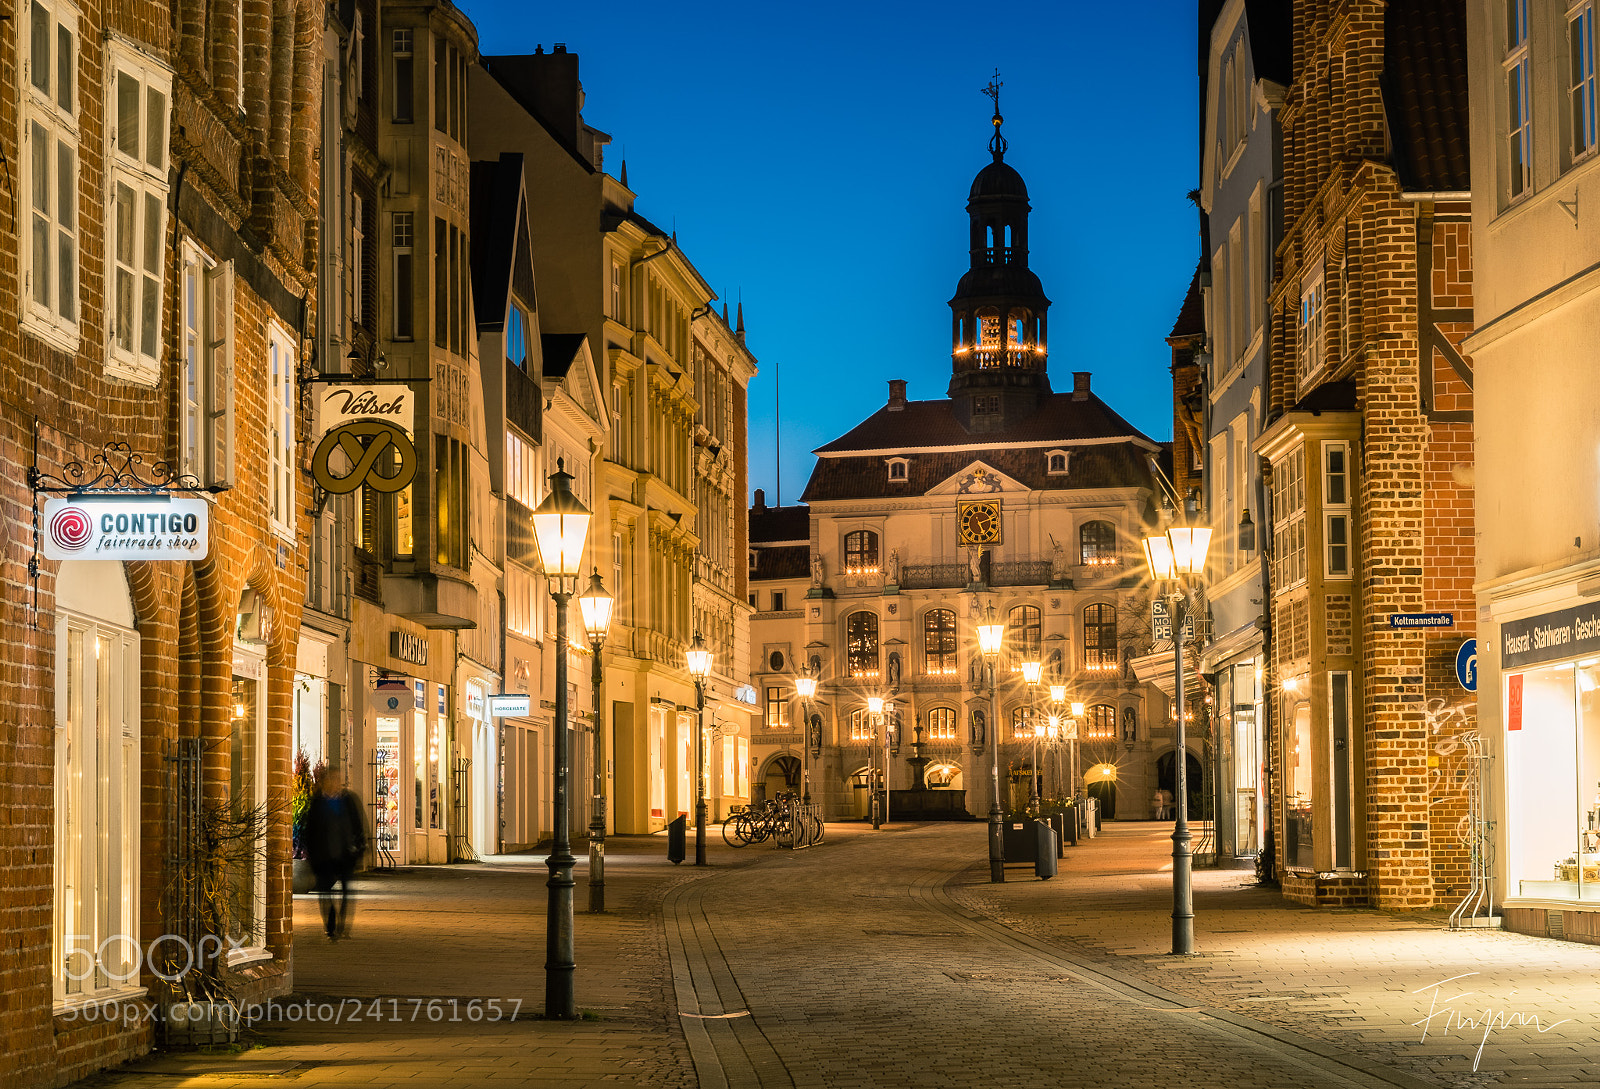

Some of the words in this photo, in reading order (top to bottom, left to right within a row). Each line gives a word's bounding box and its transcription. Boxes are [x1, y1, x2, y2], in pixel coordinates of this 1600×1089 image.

[324, 389, 405, 415] Völsch
[100, 513, 197, 533] CONTIGO
[96, 535, 162, 552] fairtrade
[166, 535, 199, 550] shop
[1505, 630, 1530, 655] Hausrat
[1534, 624, 1571, 650] Stahlwaren
[1575, 614, 1600, 641] Gesche
